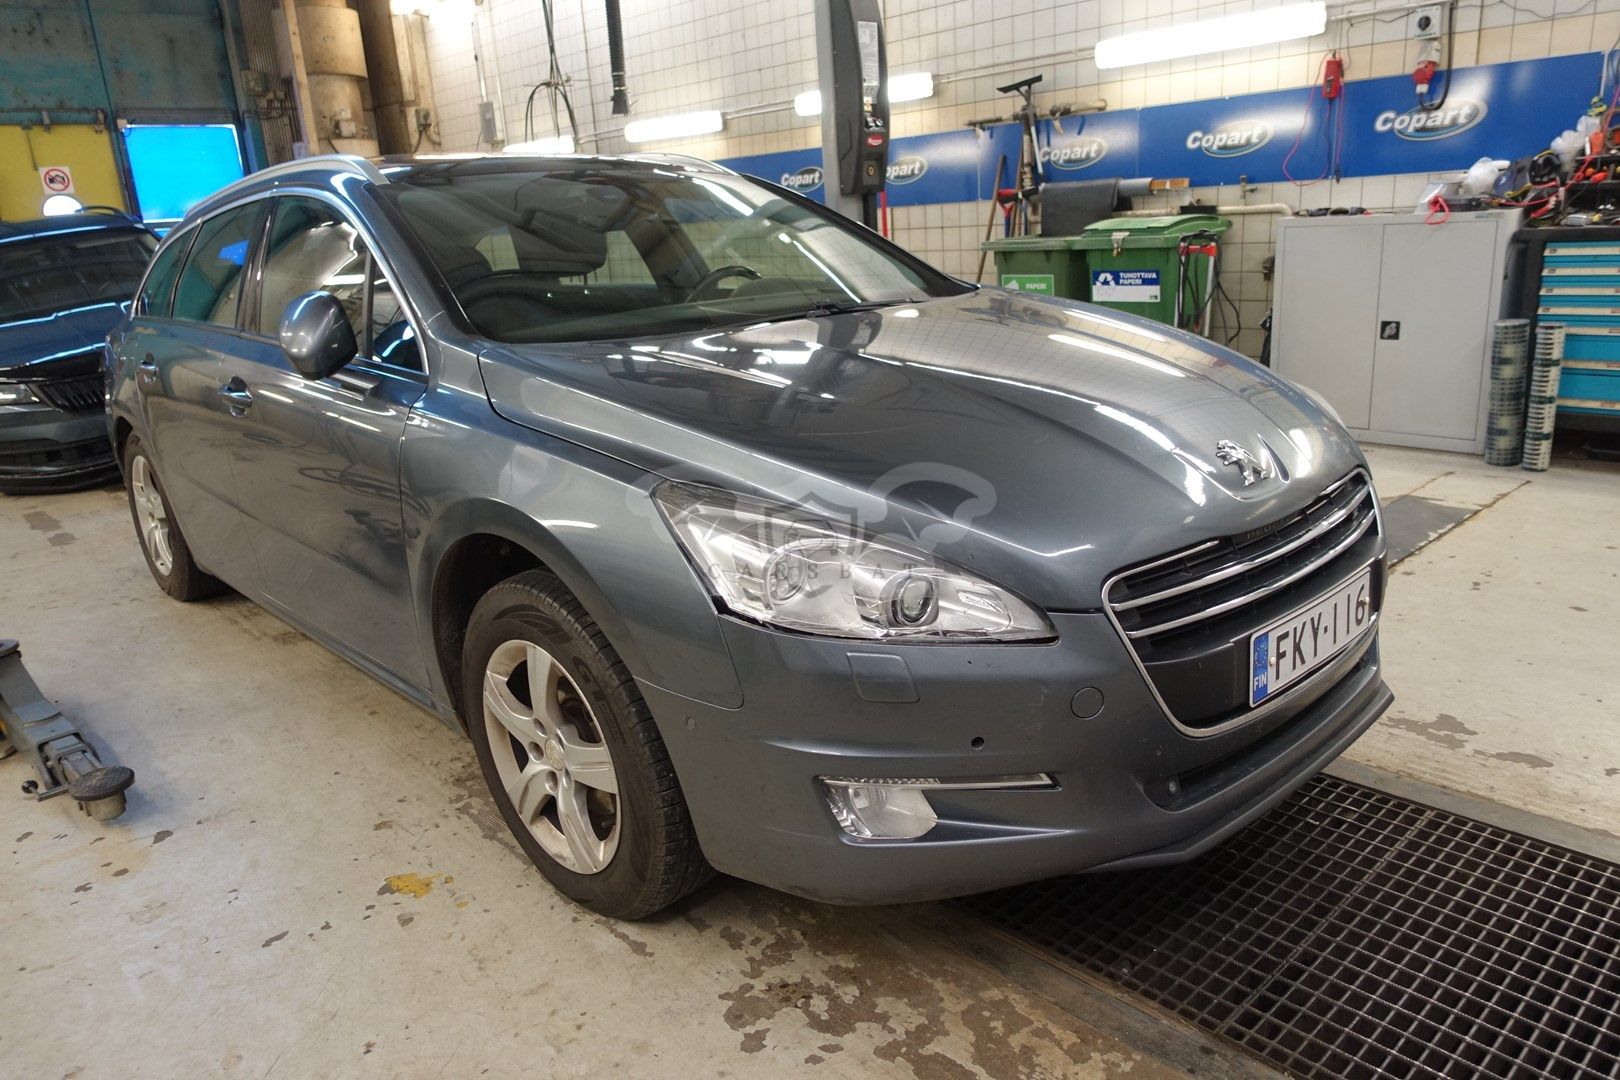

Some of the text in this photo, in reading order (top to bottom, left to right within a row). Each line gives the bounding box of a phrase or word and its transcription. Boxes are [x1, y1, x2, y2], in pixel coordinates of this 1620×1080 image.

[1375, 105, 1471, 132] Copart
[1187, 127, 1262, 150] Copart
[1039, 142, 1099, 164] Copart
[781, 172, 820, 187] Copart
[886, 161, 921, 181] opart
[1025, 282, 1047, 290] PAPERI
[1275, 583, 1367, 680] FKY-116
[1254, 672, 1267, 691] FIN
